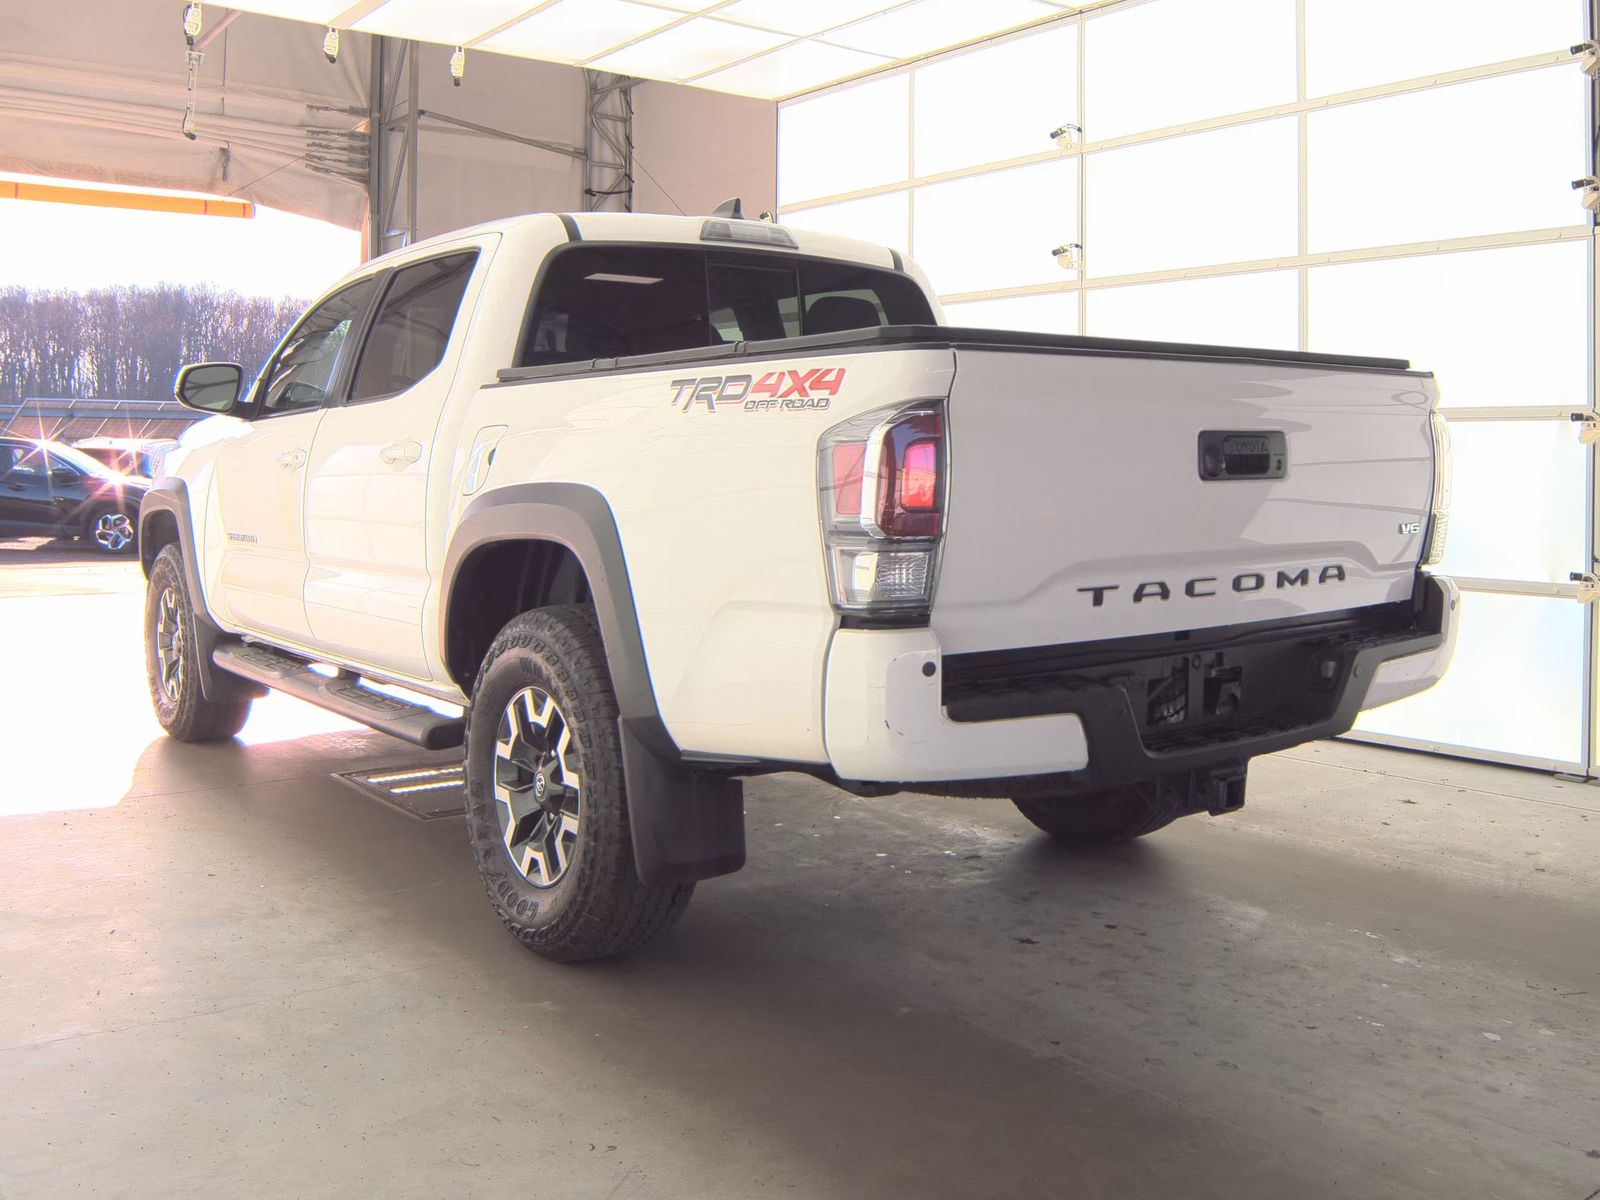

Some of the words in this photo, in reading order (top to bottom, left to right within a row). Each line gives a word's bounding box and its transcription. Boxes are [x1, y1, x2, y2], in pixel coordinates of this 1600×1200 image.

[671, 374, 752, 413] TRD
[744, 399, 777, 411] OFF
[779, 397, 831, 411] ROAD
[1398, 522, 1420, 535] V6
[1077, 564, 1346, 607] TACOMA
